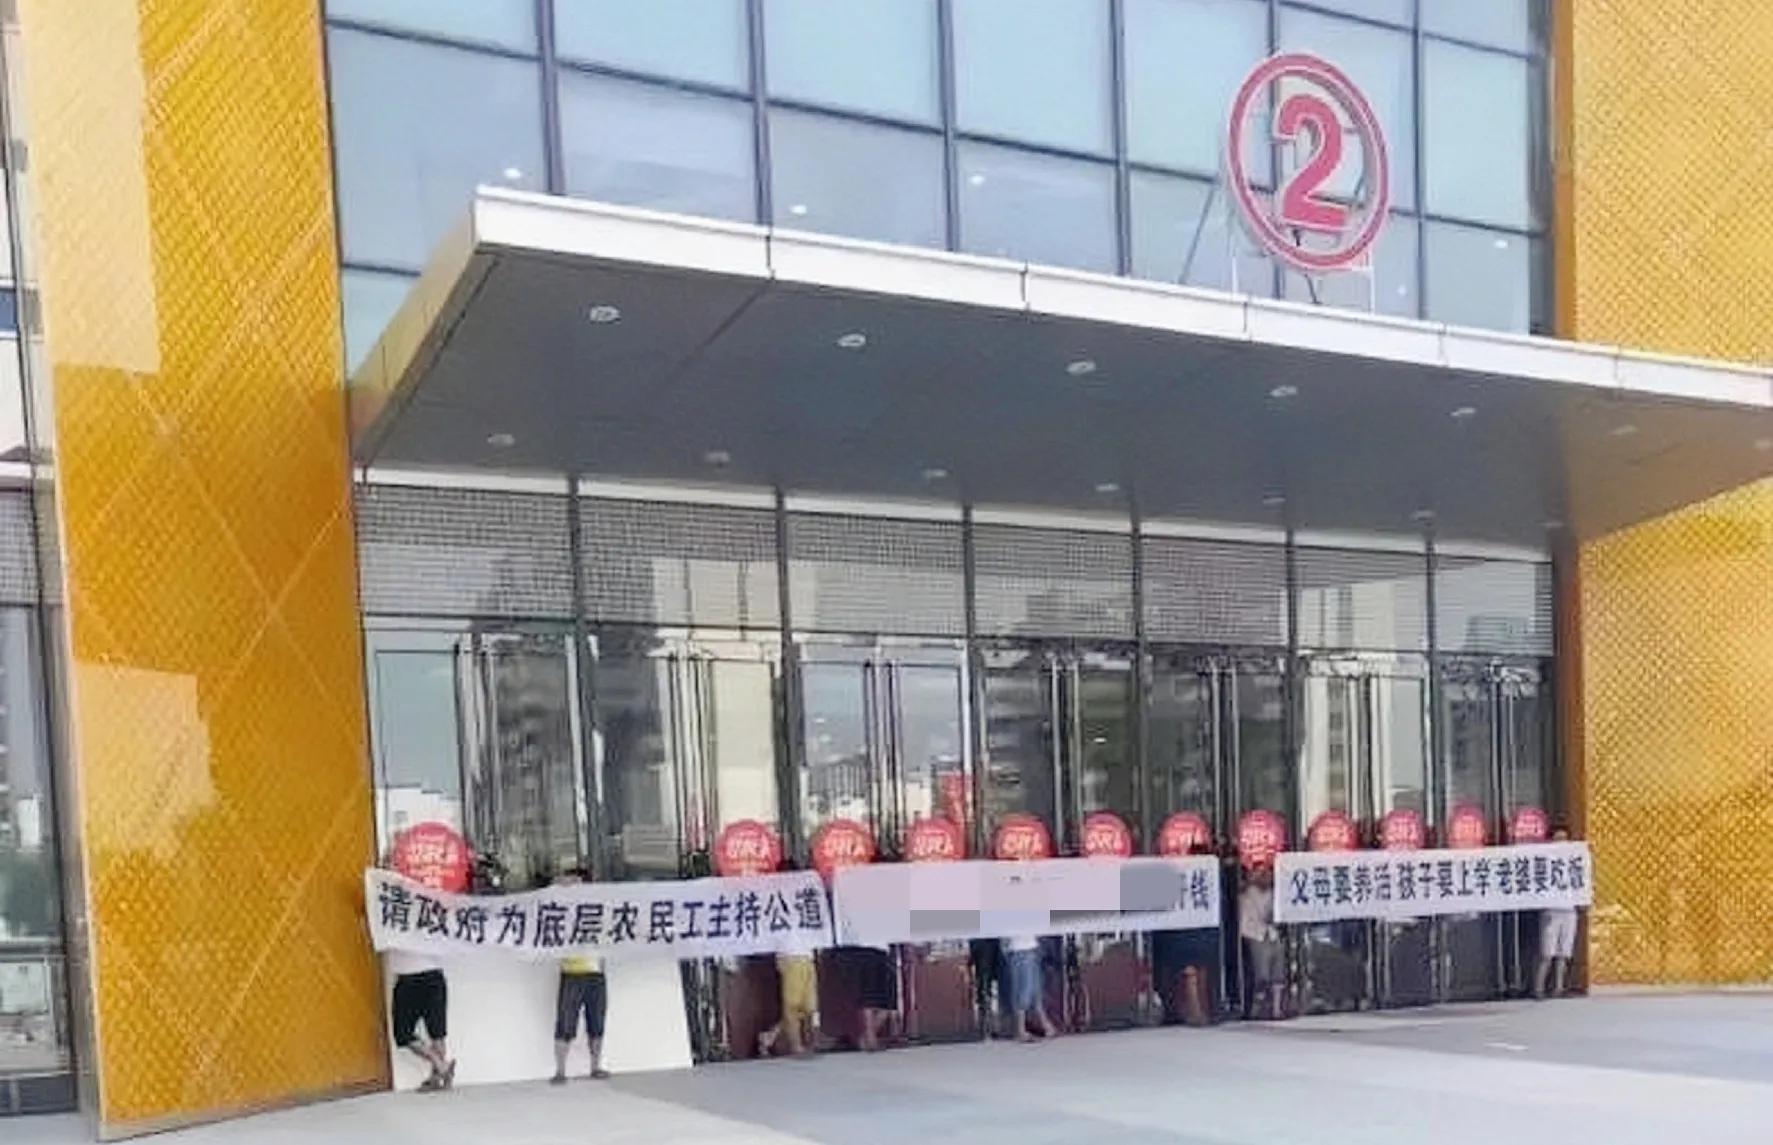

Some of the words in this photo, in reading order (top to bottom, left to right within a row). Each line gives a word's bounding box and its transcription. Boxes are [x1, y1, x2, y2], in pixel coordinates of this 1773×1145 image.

[1275, 94, 1348, 229] 2
[378, 881, 825, 948] 请政府为底层农民工主持公道
